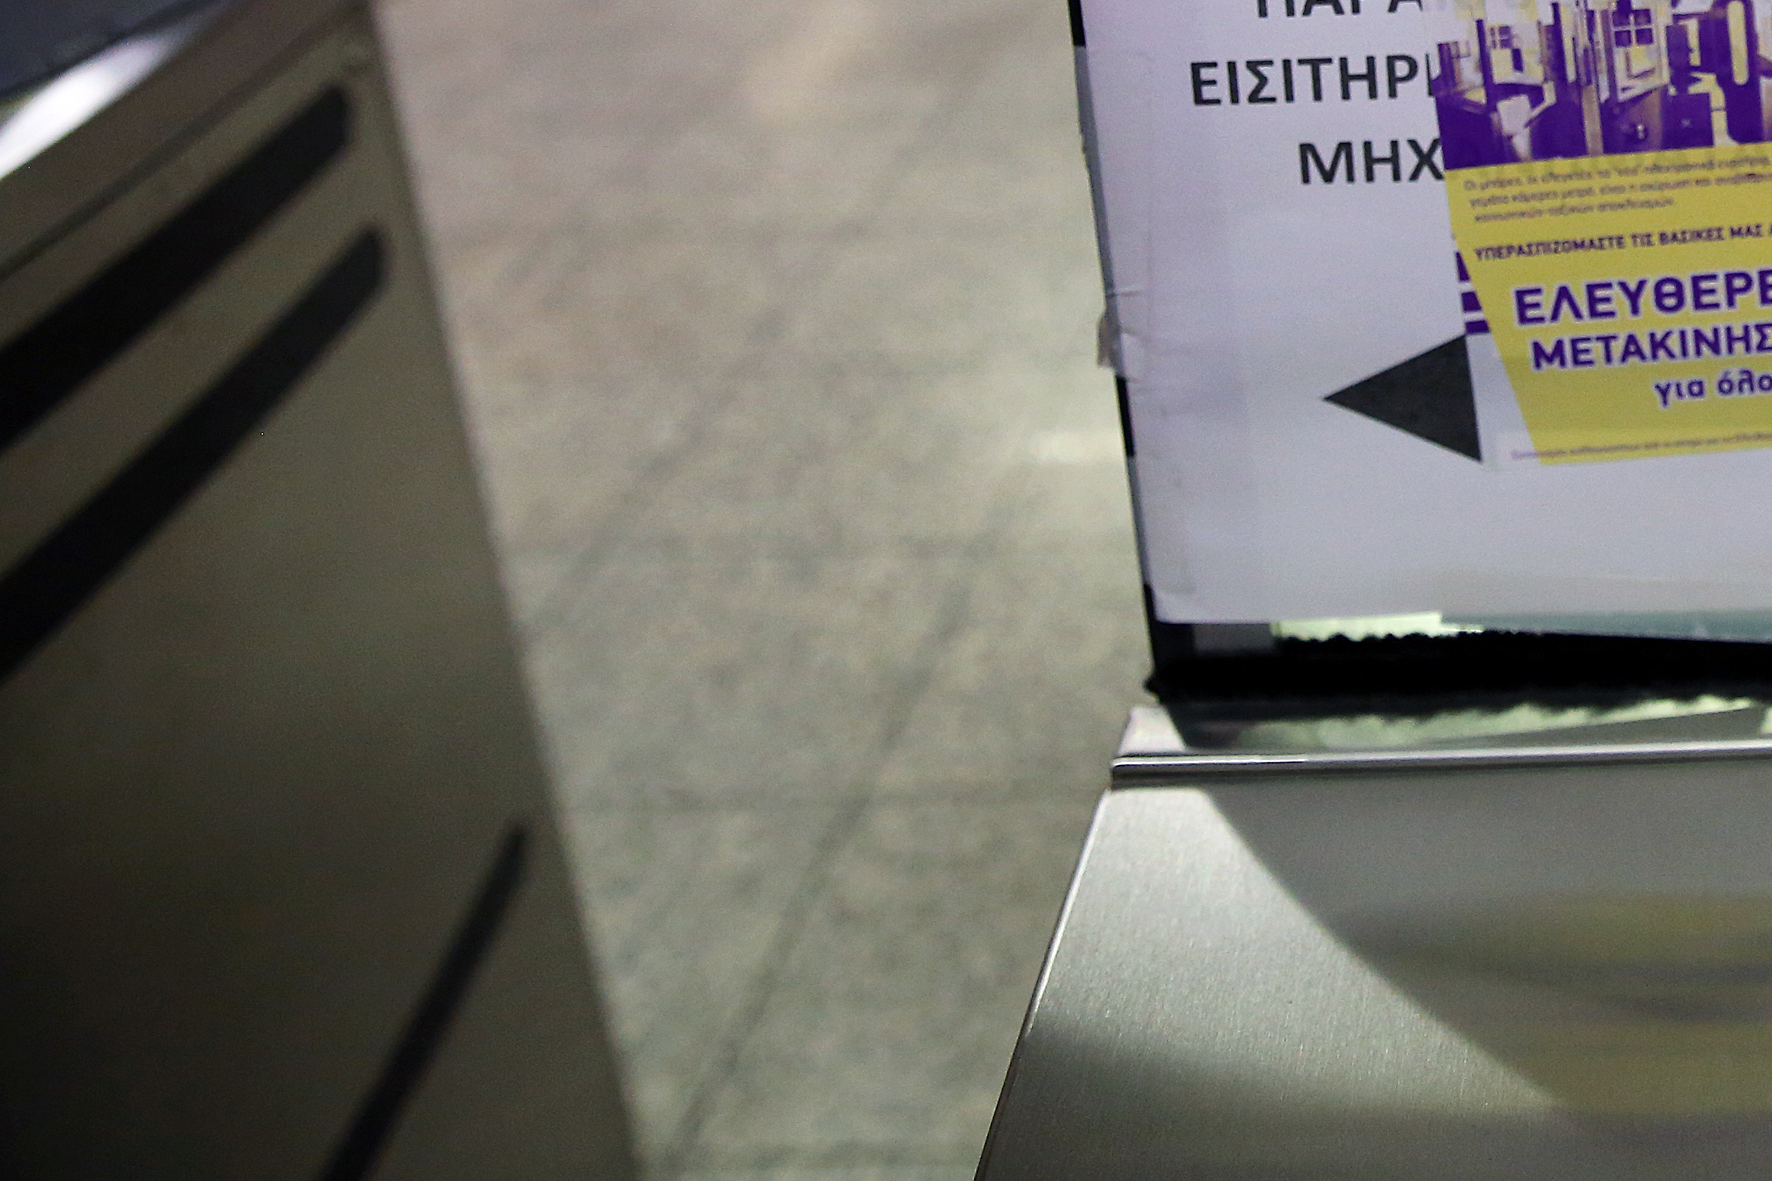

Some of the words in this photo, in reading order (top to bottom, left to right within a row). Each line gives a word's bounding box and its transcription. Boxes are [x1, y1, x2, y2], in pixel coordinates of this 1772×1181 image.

[1191, 54, 1435, 106] ΕΙΣΙΤΗΡΙ
[1729, 223, 1763, 239] ΜΑΣ
[1654, 379, 1705, 408] για
